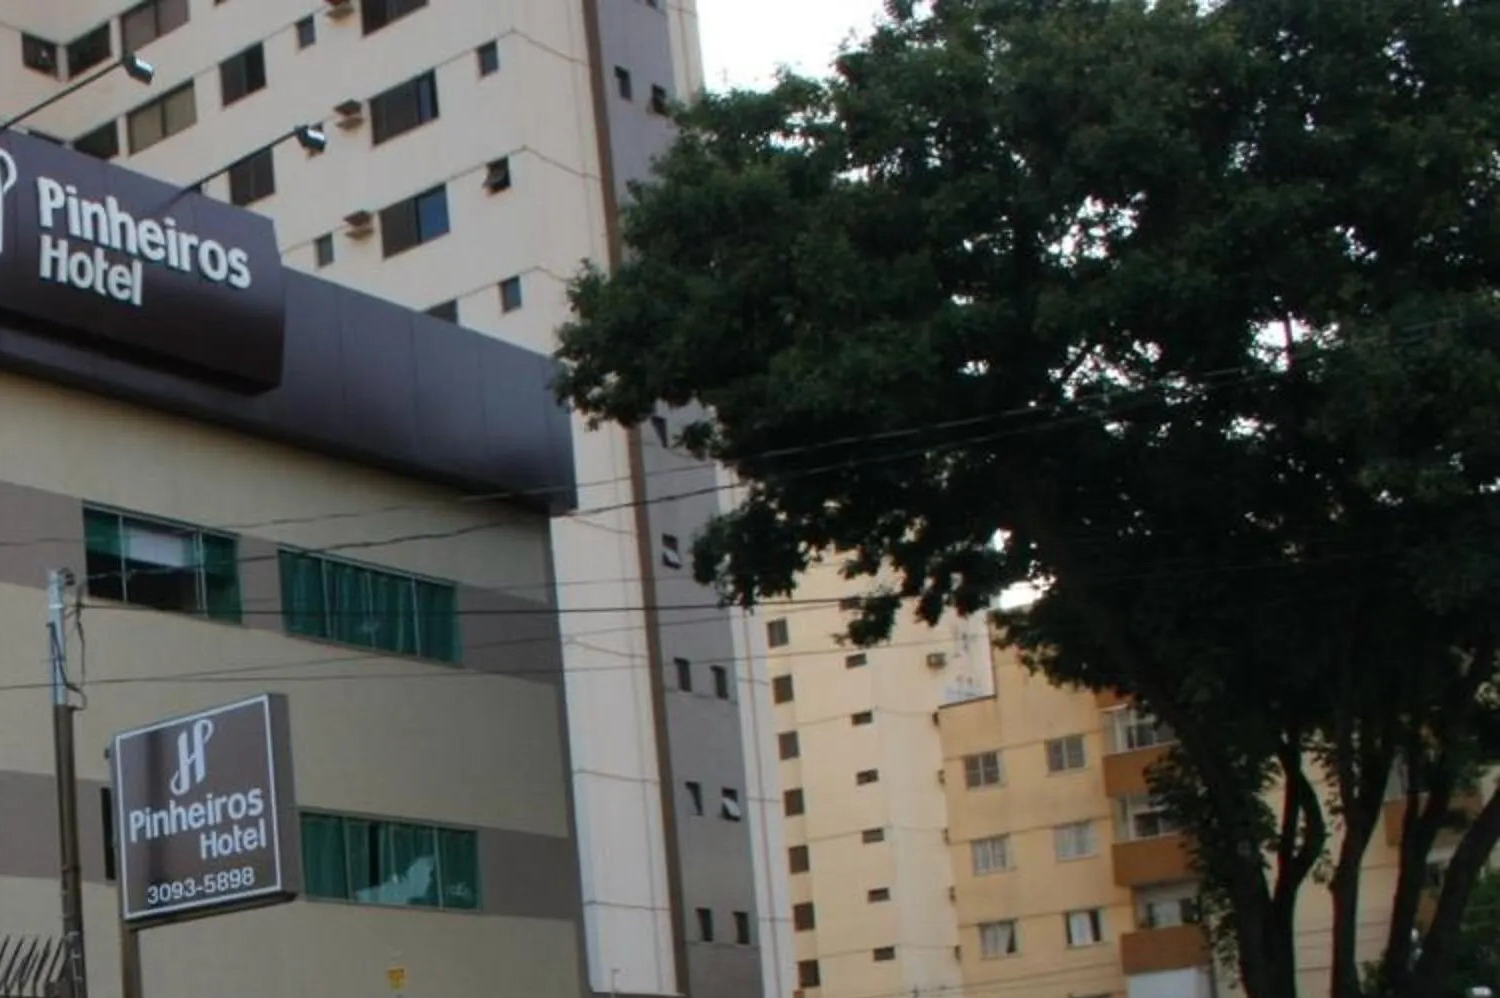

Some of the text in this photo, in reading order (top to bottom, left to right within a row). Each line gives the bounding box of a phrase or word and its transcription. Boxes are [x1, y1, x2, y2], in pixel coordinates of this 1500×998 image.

[37, 176, 250, 288] Pinheiros
[40, 235, 142, 306] Hotel
[129, 788, 264, 843] Pinheiros
[201, 818, 266, 859] Hotel
[148, 866, 255, 904] 3093-5898
